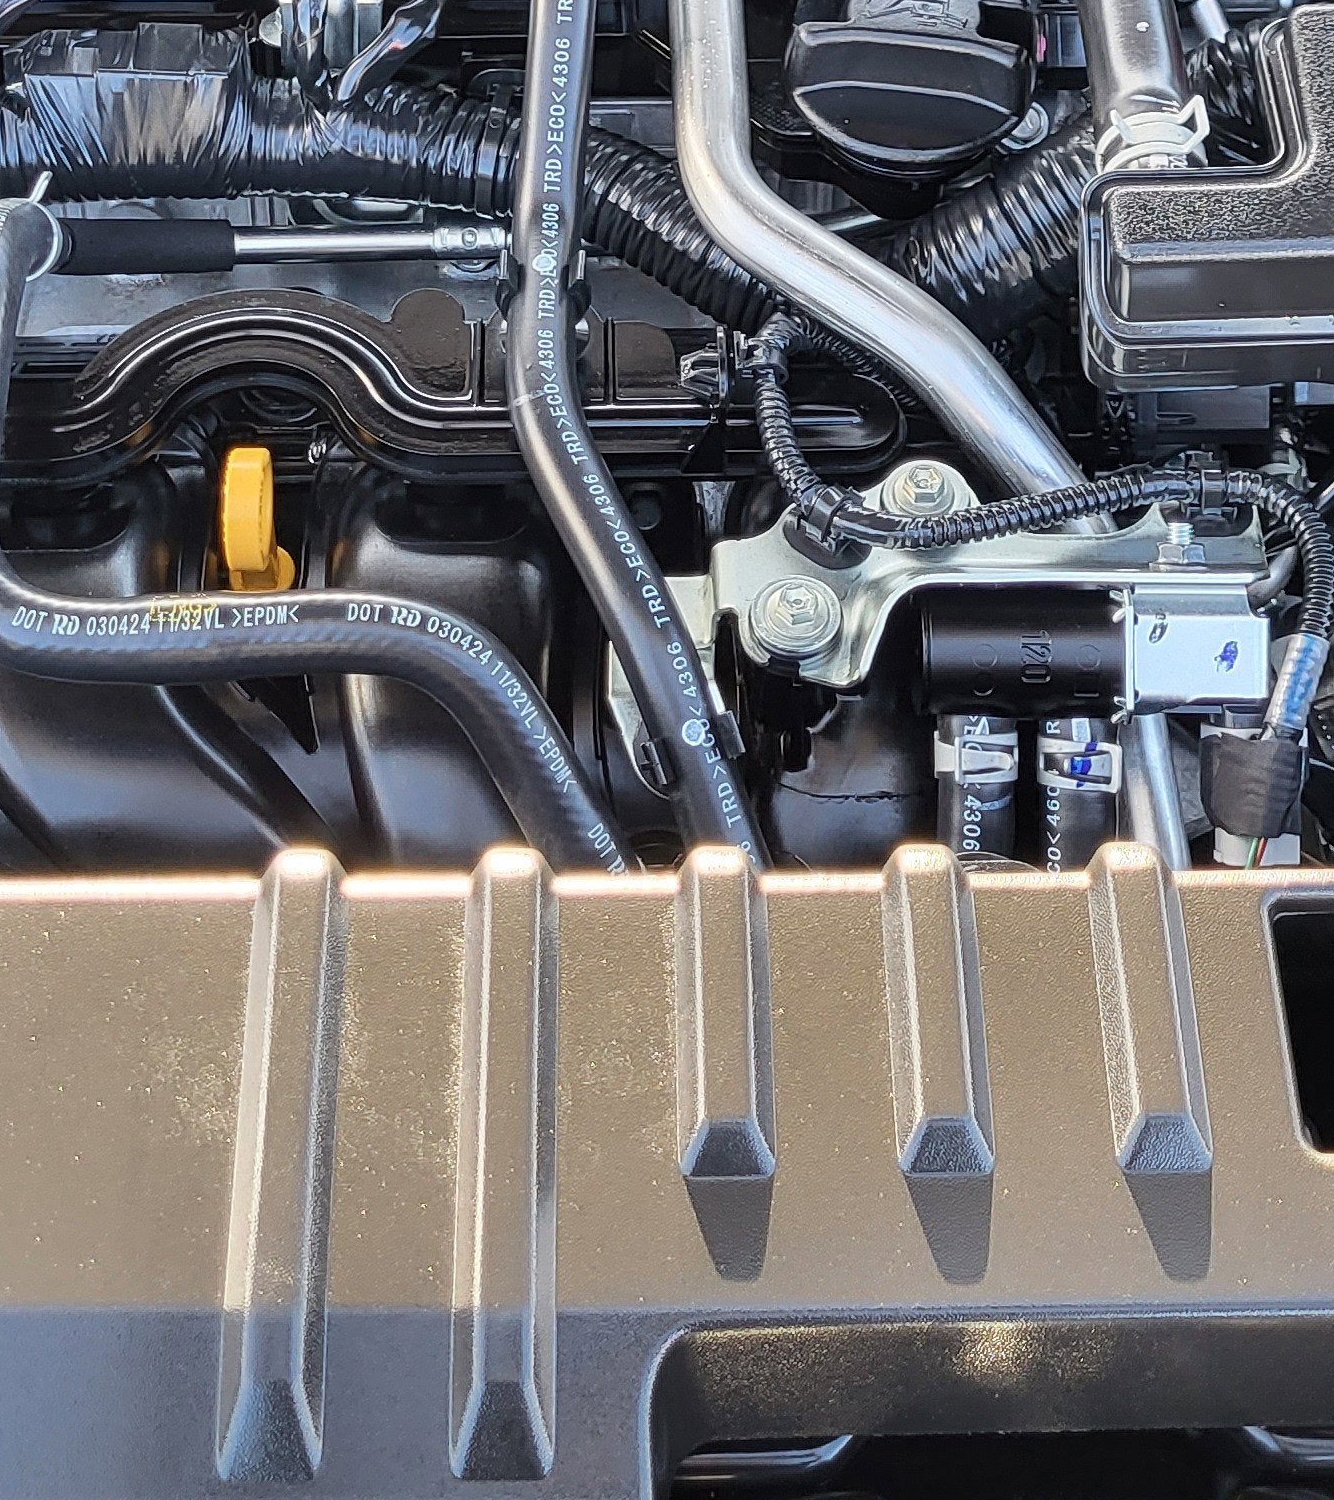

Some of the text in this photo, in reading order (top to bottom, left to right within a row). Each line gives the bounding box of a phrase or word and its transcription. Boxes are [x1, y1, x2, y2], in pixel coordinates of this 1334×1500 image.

[11, 605, 49, 633] DOT
[85, 613, 151, 636] 030424
[346, 602, 384, 623] DOT
[426, 615, 494, 666] 030424
[587, 821, 618, 859] DOT
